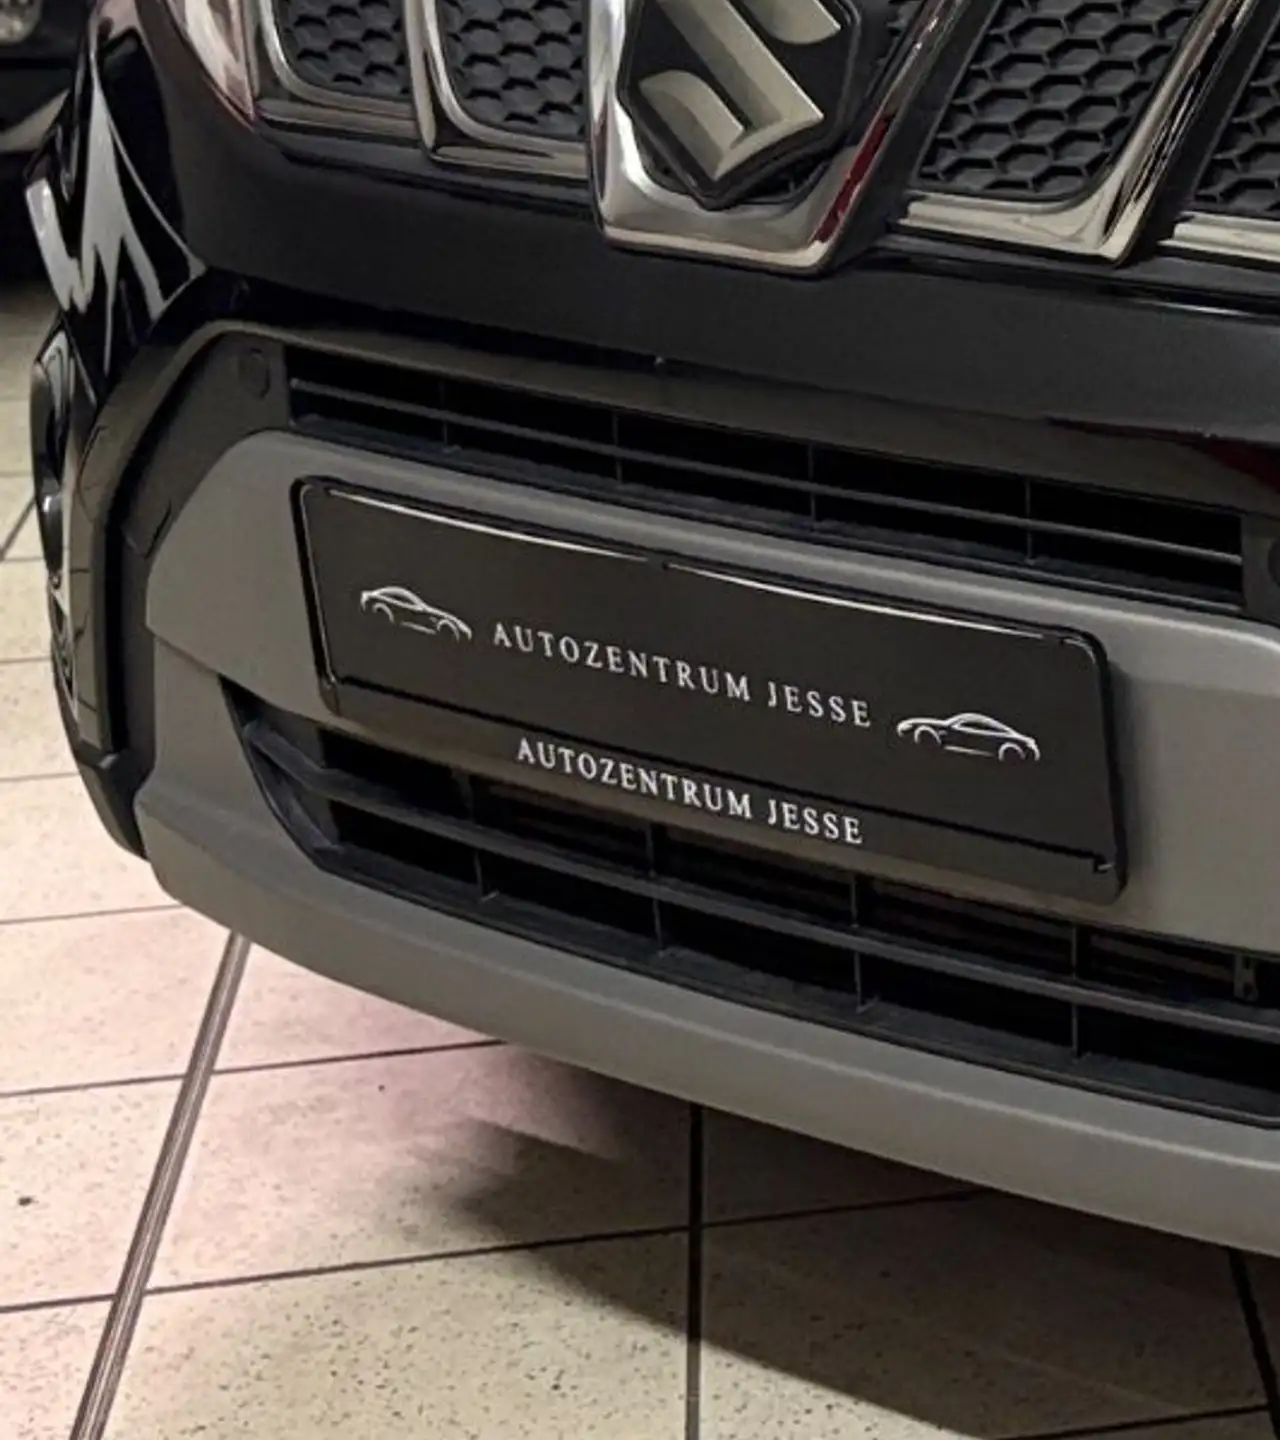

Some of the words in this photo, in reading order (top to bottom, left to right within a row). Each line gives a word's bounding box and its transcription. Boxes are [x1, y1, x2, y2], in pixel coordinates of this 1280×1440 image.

[493, 621, 751, 703] AUTOZENTRUM
[767, 681, 872, 729] JESSE
[517, 736, 753, 820] AUTOZENTRUM
[767, 799, 864, 846] JESSE
